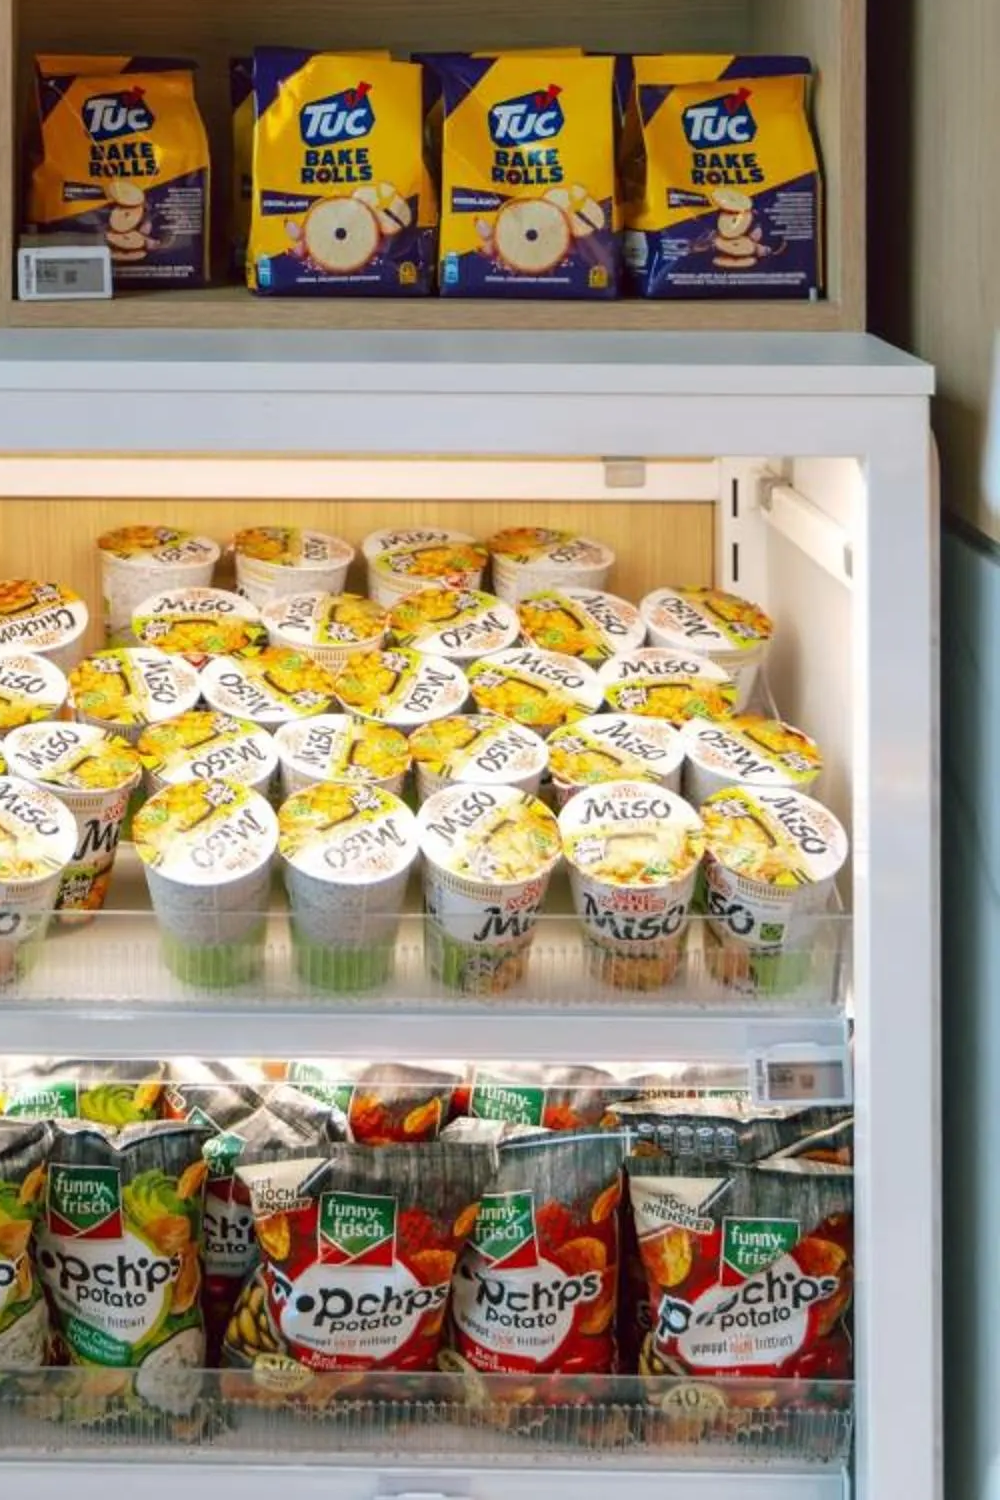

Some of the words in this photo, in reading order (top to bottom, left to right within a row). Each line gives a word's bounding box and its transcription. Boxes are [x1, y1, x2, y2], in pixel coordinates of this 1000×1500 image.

[91, 142, 154, 161] BAKE
[305, 147, 369, 167] BAKE
[495, 148, 559, 167] BAKE
[692, 152, 757, 169] BAKE
[89, 160, 159, 178] ROLLS
[301, 165, 373, 184] ROLLS
[491, 165, 564, 185] ROLLS
[691, 168, 765, 185] ROLLS
[153, 597, 235, 613] Miso
[570, 595, 629, 637] Miso
[660, 597, 721, 639] Miso
[440, 610, 510, 649] Miso
[138, 655, 178, 705] Miso
[504, 651, 585, 690] Miso
[619, 659, 701, 679] Miso
[219, 672, 284, 716] Miso
[404, 667, 457, 713] Miso
[14, 729, 81, 772] Miso
[294, 725, 338, 770] Miso
[476, 731, 538, 773] Miso
[593, 719, 668, 762] Miso
[698, 729, 776, 778] Miso
[191, 738, 267, 780] Miso
[426, 791, 497, 846] Miso
[580, 799, 672, 825] Miso
[760, 792, 828, 855] Miso
[73, 819, 121, 861] Mi
[191, 809, 267, 869] Miso
[324, 817, 407, 870] Miso
[583, 891, 686, 942] Miso
[708, 891, 756, 935] so
[55, 1172, 113, 1197] funny-
[61, 1193, 112, 1215] frisch
[327, 1199, 384, 1221] funny-
[478, 1206, 520, 1227] unny-
[641, 1202, 713, 1232] INTENSIVER
[333, 1218, 385, 1238] frisch
[475, 1222, 526, 1242] frisch
[731, 1223, 787, 1251] funny-
[76, 1281, 147, 1309] potato
[330, 1314, 403, 1335] potato
[485, 1306, 557, 1330] potato
[721, 1306, 791, 1332] potato
